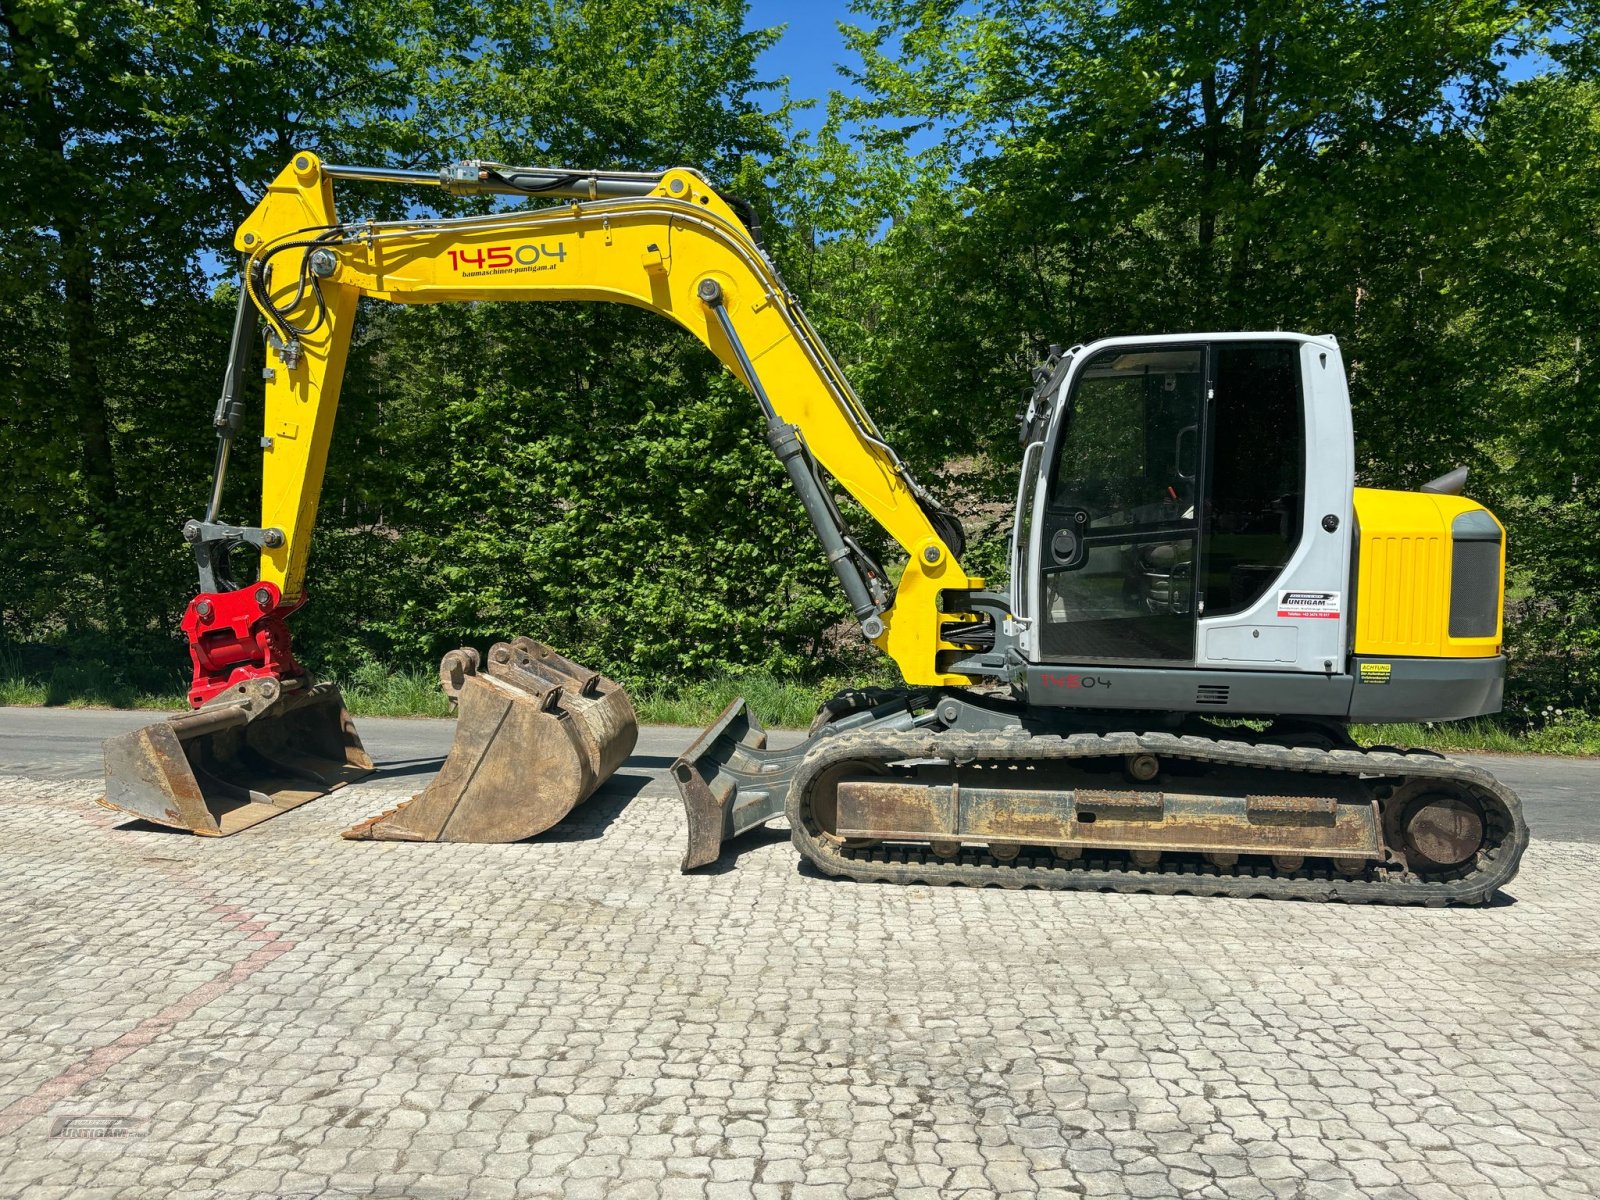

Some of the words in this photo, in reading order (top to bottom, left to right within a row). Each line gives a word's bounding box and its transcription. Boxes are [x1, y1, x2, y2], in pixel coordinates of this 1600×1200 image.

[447, 242, 567, 271] 14504
[462, 264, 557, 278] baumaschinen-puntigam.at
[1041, 673, 1112, 689] 14504
